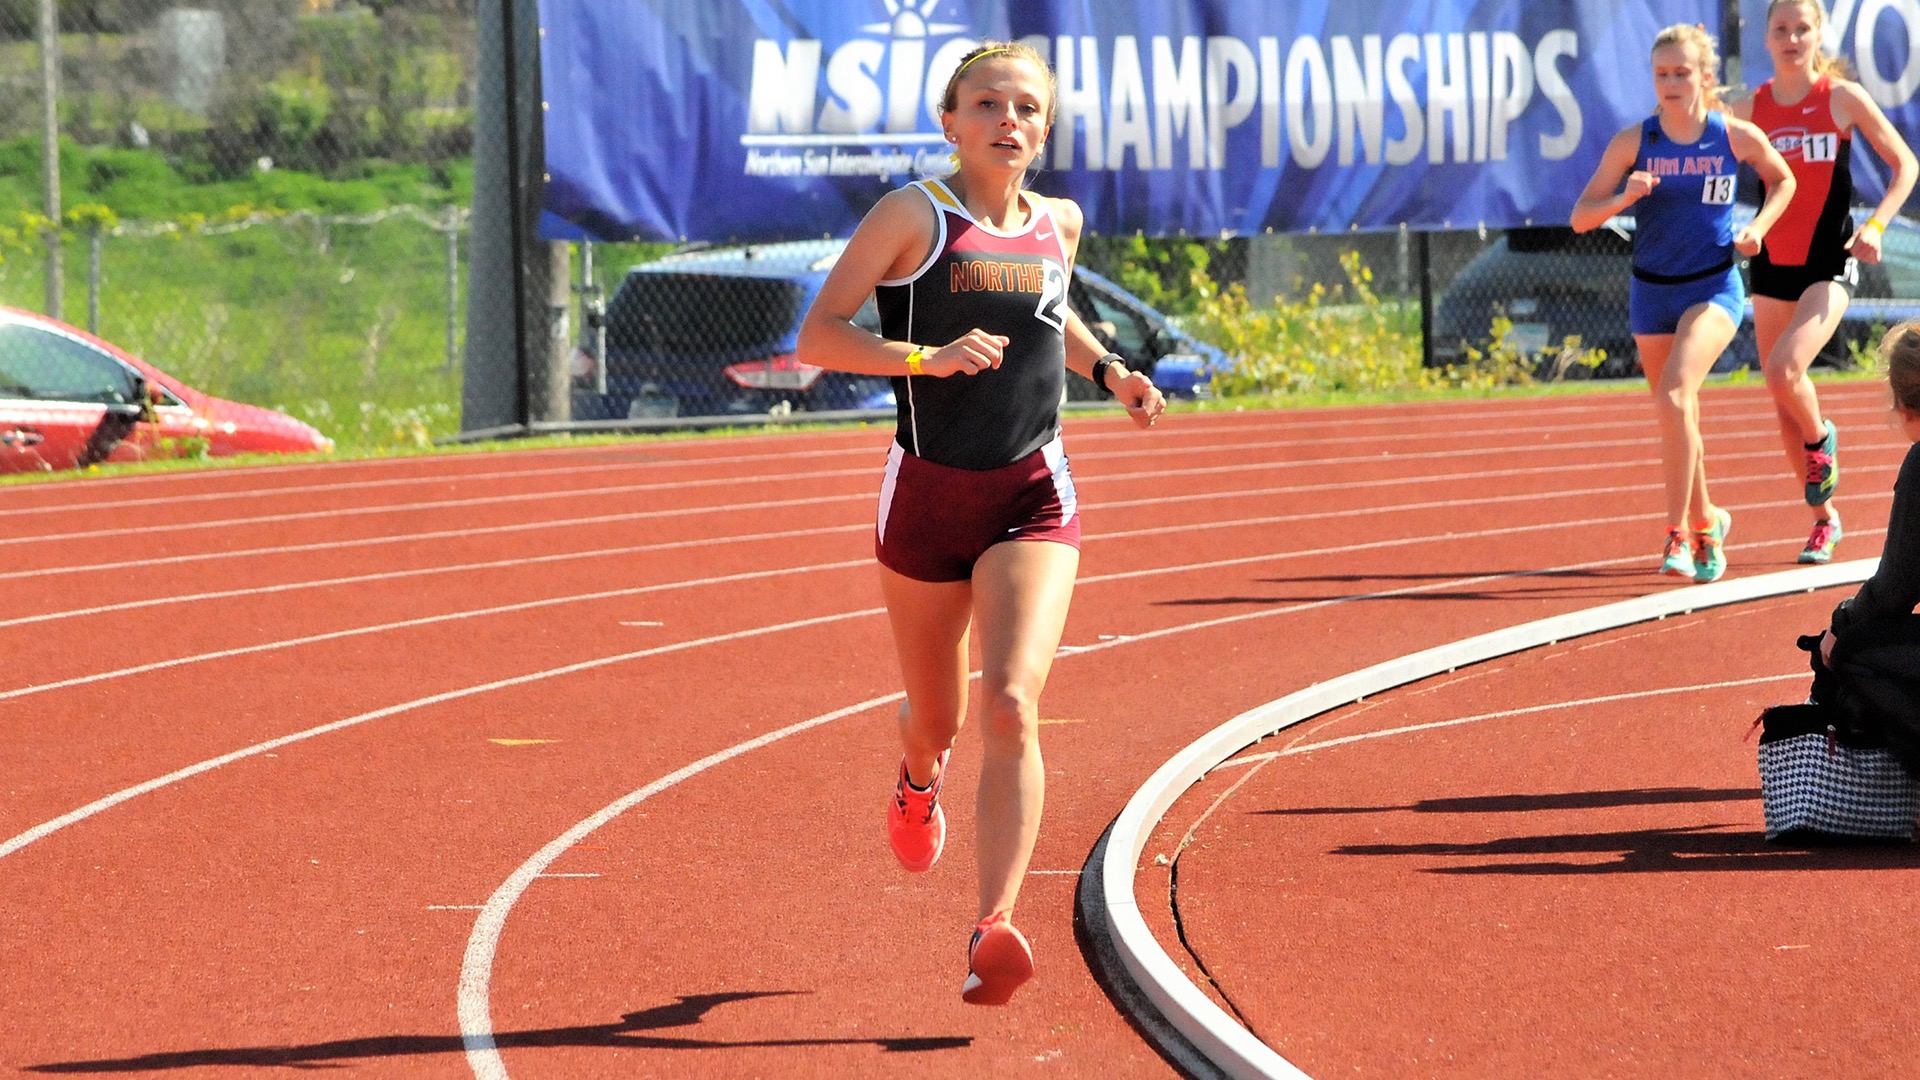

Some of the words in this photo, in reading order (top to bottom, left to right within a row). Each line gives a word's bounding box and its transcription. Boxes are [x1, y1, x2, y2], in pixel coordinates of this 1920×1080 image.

[1026, 30, 1583, 171] HAMPIONSHIPS
[744, 147, 801, 176] Northern
[803, 149, 829, 176] Sun
[1804, 136, 1828, 159] 11
[1708, 177, 1731, 202] 13
[1041, 268, 1065, 327] 2
